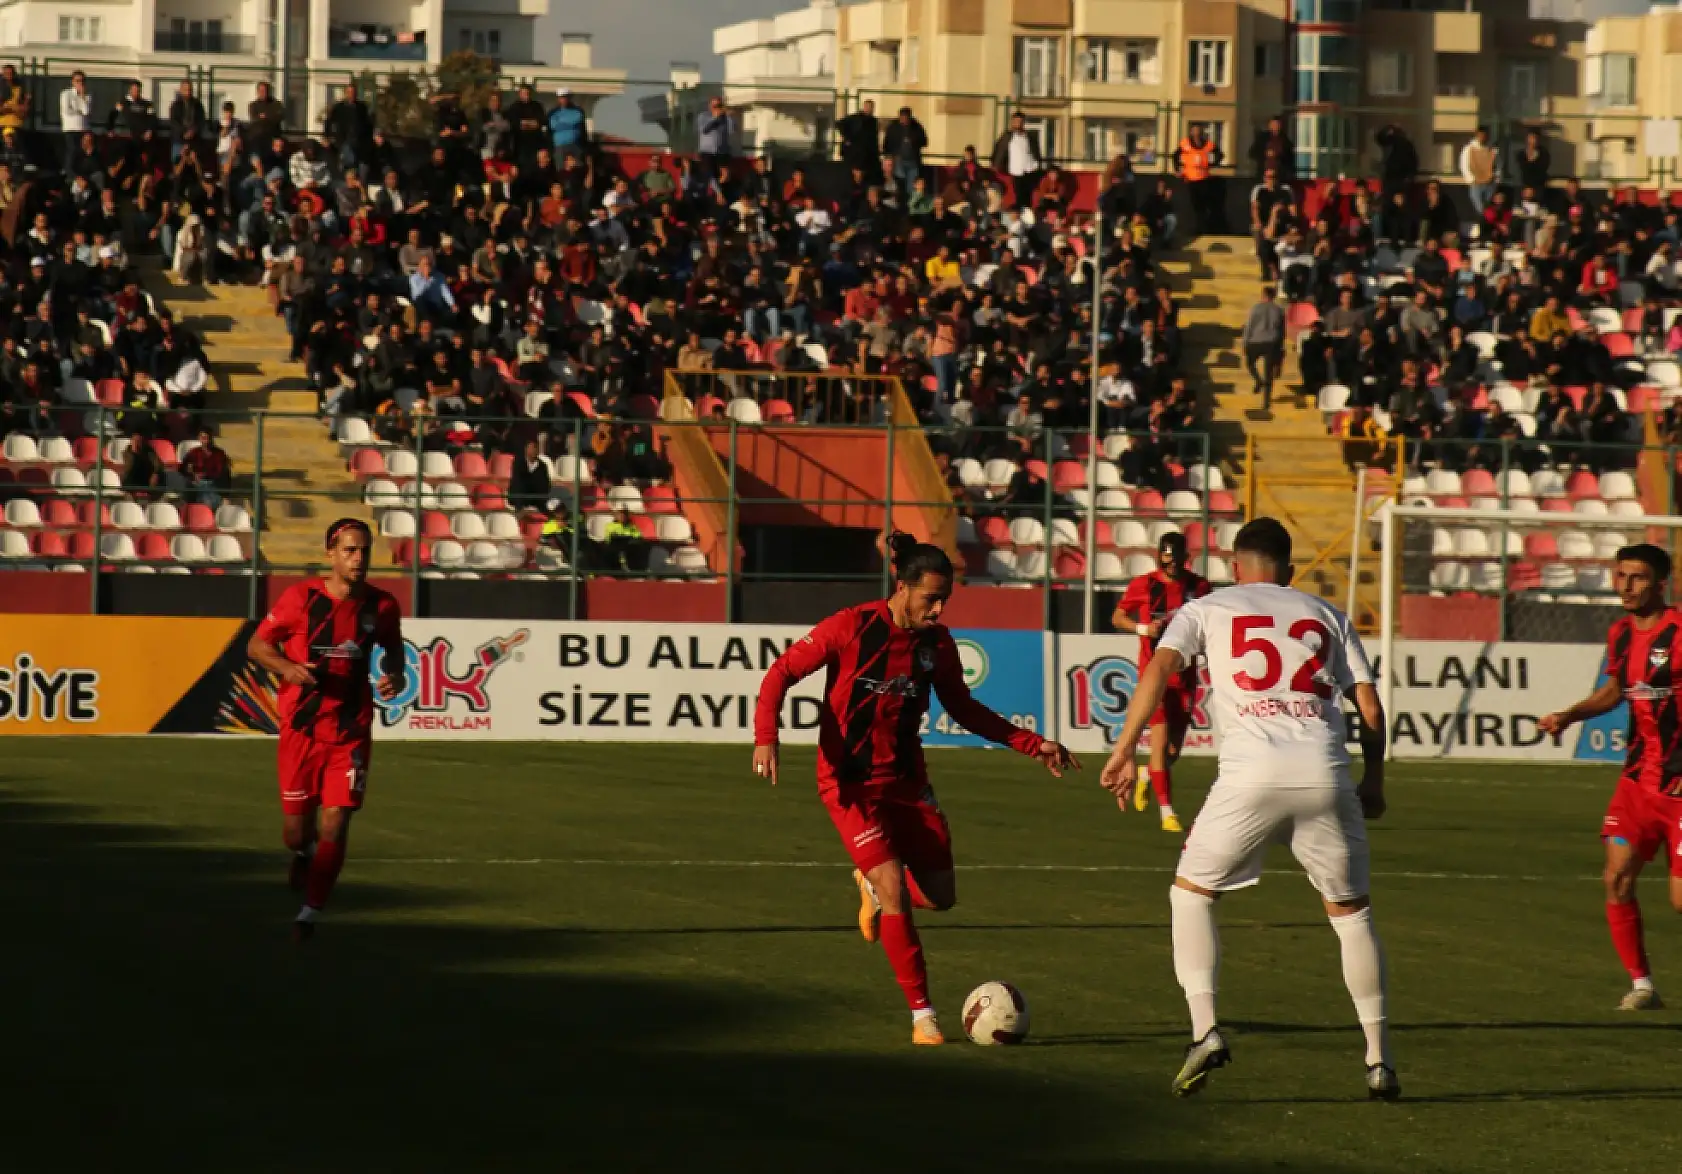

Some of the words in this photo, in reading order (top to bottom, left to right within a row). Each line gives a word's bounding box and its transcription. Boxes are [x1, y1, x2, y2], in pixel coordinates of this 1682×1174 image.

[559, 633, 631, 668] BU
[648, 635, 793, 671] ALAN
[1231, 615, 1333, 700] 52
[409, 714, 492, 730] REKLAM
[539, 683, 653, 727] SİZE
